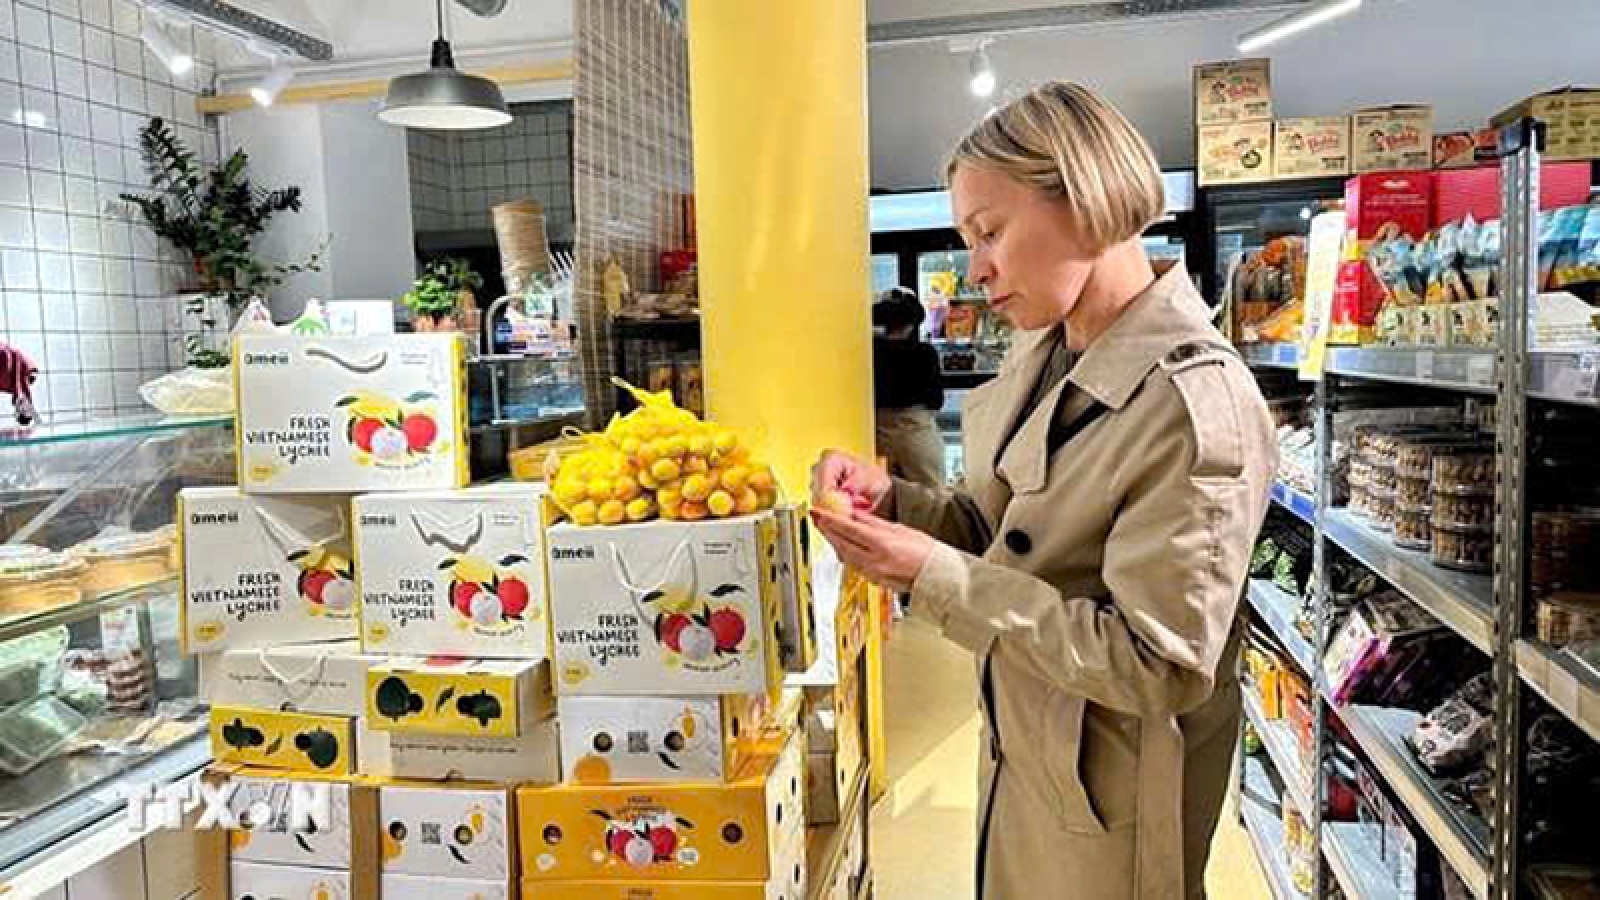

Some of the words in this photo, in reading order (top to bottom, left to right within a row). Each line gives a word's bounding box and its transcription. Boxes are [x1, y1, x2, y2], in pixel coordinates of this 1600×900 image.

[289, 416, 331, 431] FRESH
[245, 430, 331, 445] VIETNAMESE
[237, 571, 281, 586] FRESH
[191, 587, 281, 604] VIETNAMESE
[363, 593, 435, 607] VIETNAMESE
[597, 613, 639, 628] FRESH
[556, 628, 639, 644] VIETNAMESE
